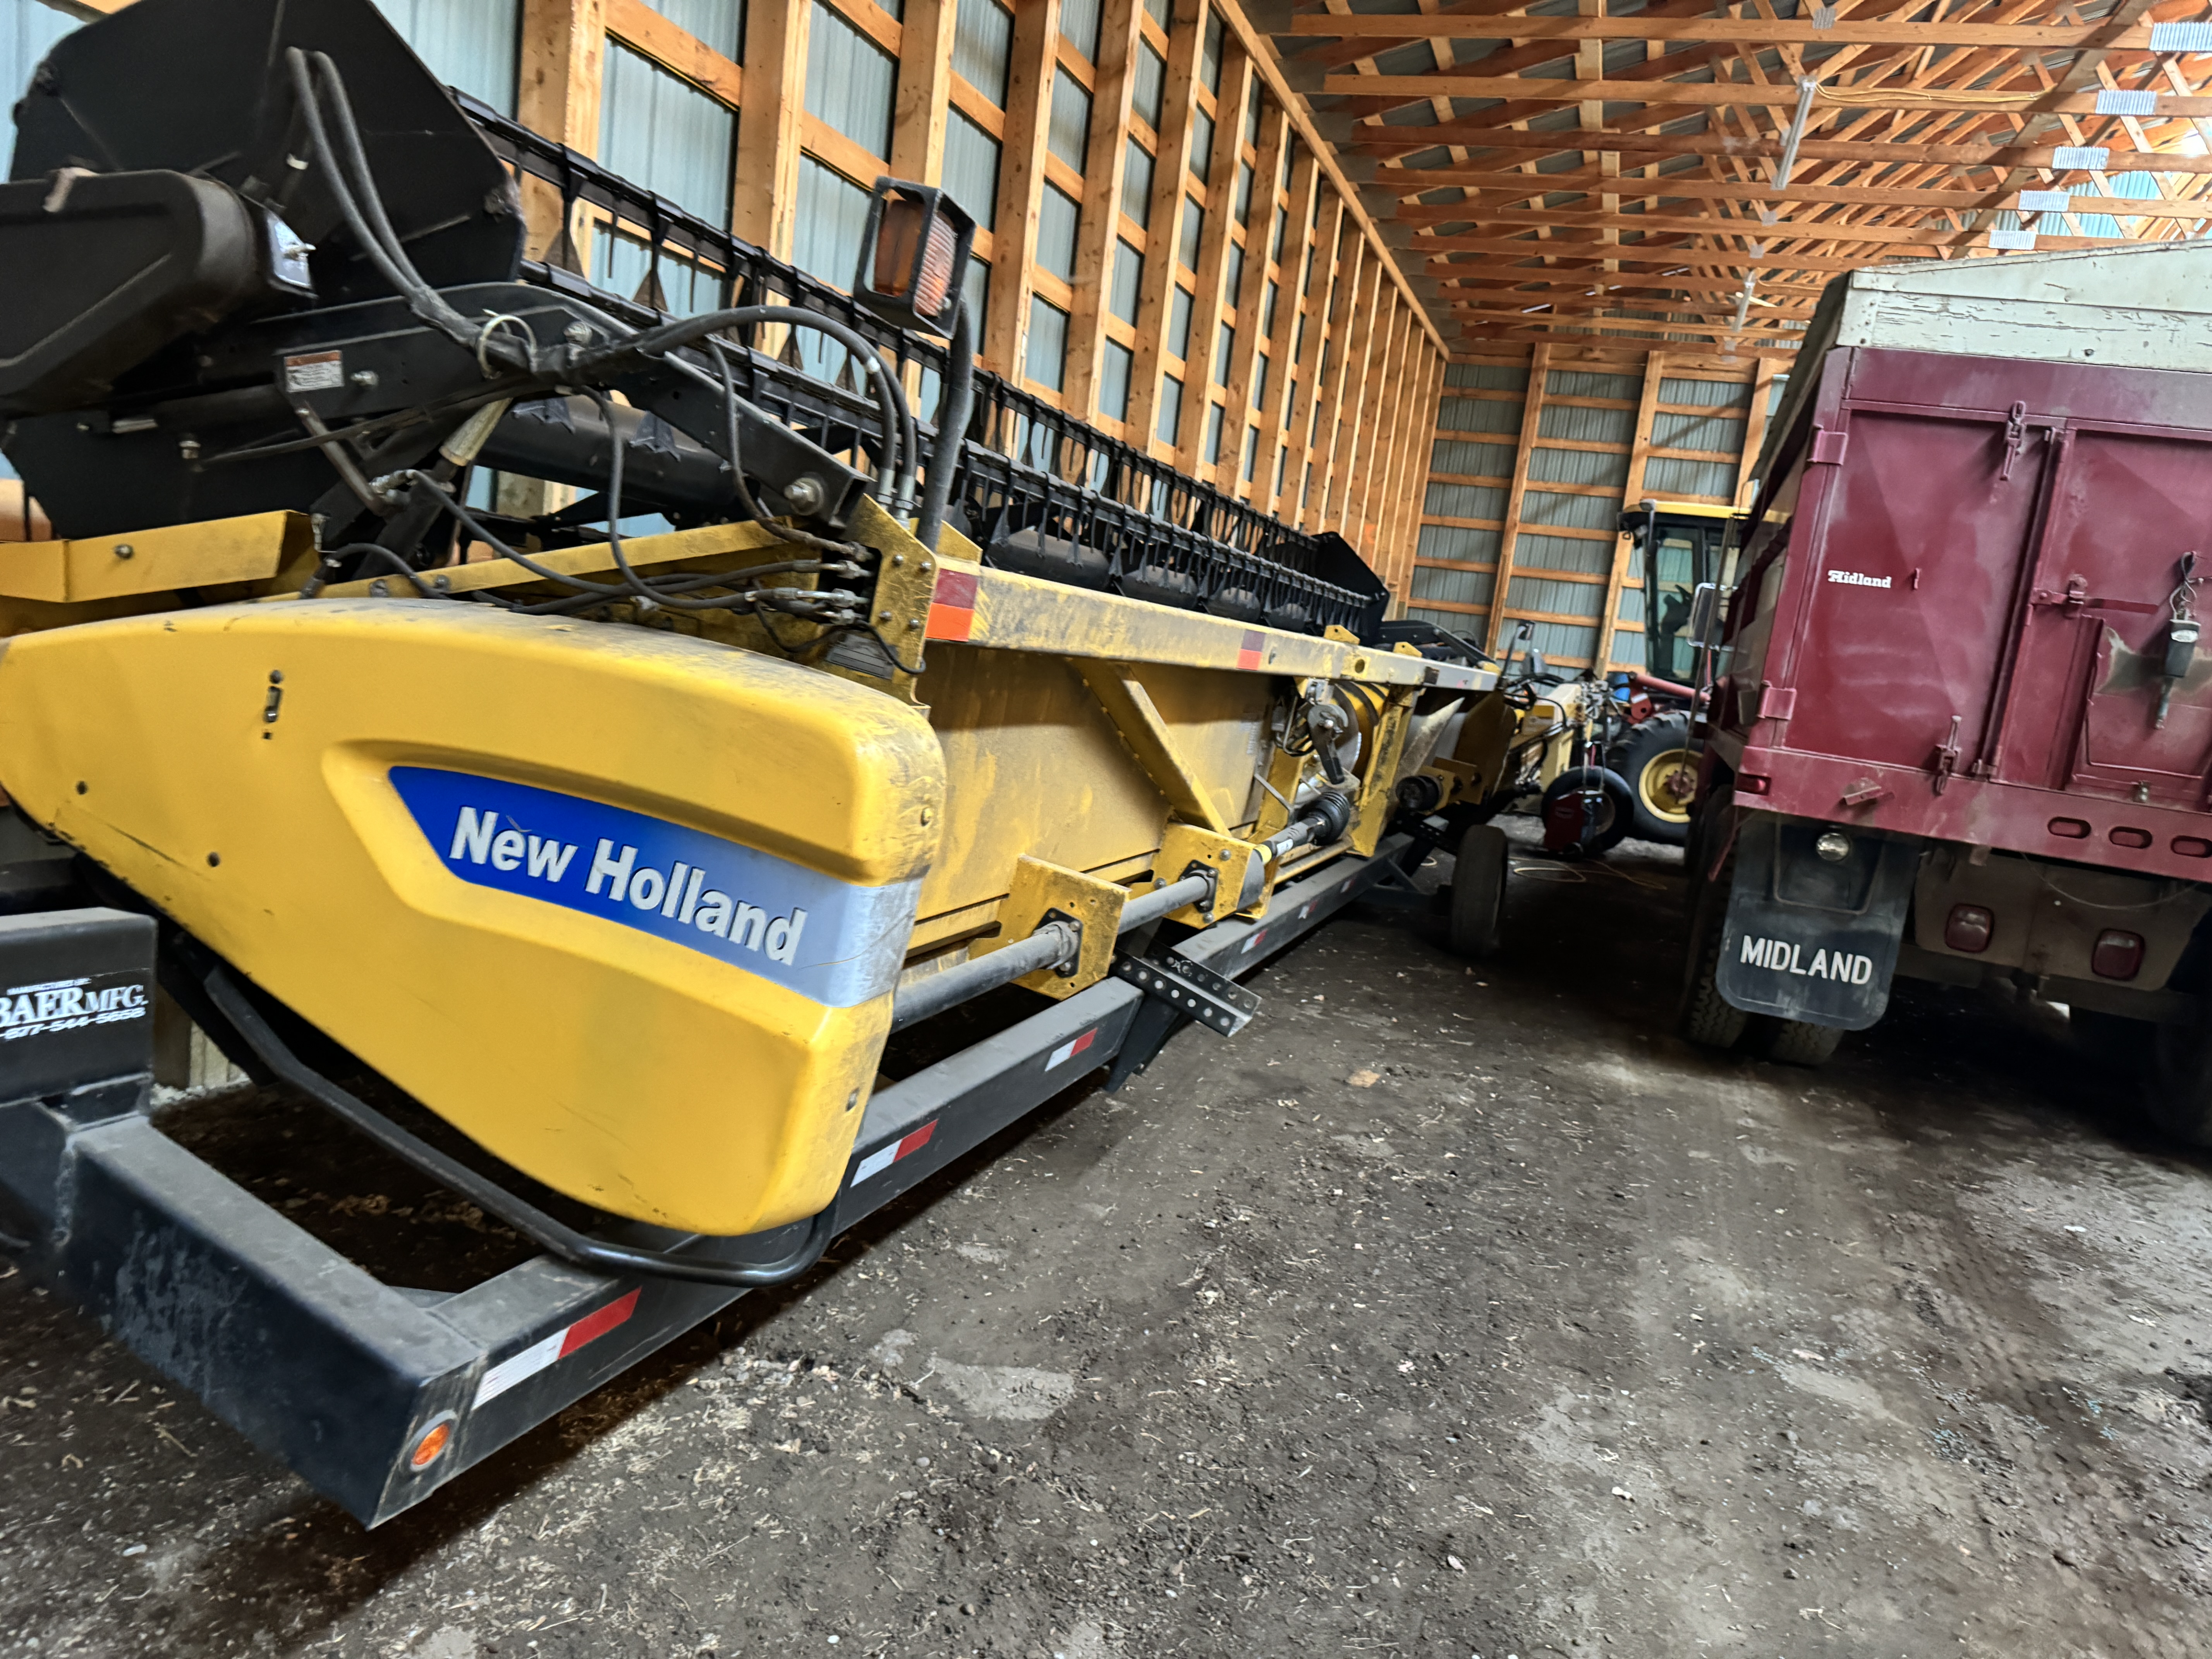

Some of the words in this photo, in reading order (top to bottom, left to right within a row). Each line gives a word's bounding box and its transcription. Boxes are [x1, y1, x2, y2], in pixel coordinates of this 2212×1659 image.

[1828, 570, 1892, 589] Midland
[449, 806, 578, 883] New
[585, 838, 808, 967] Holland
[1740, 935, 1873, 985] MIDLAND
